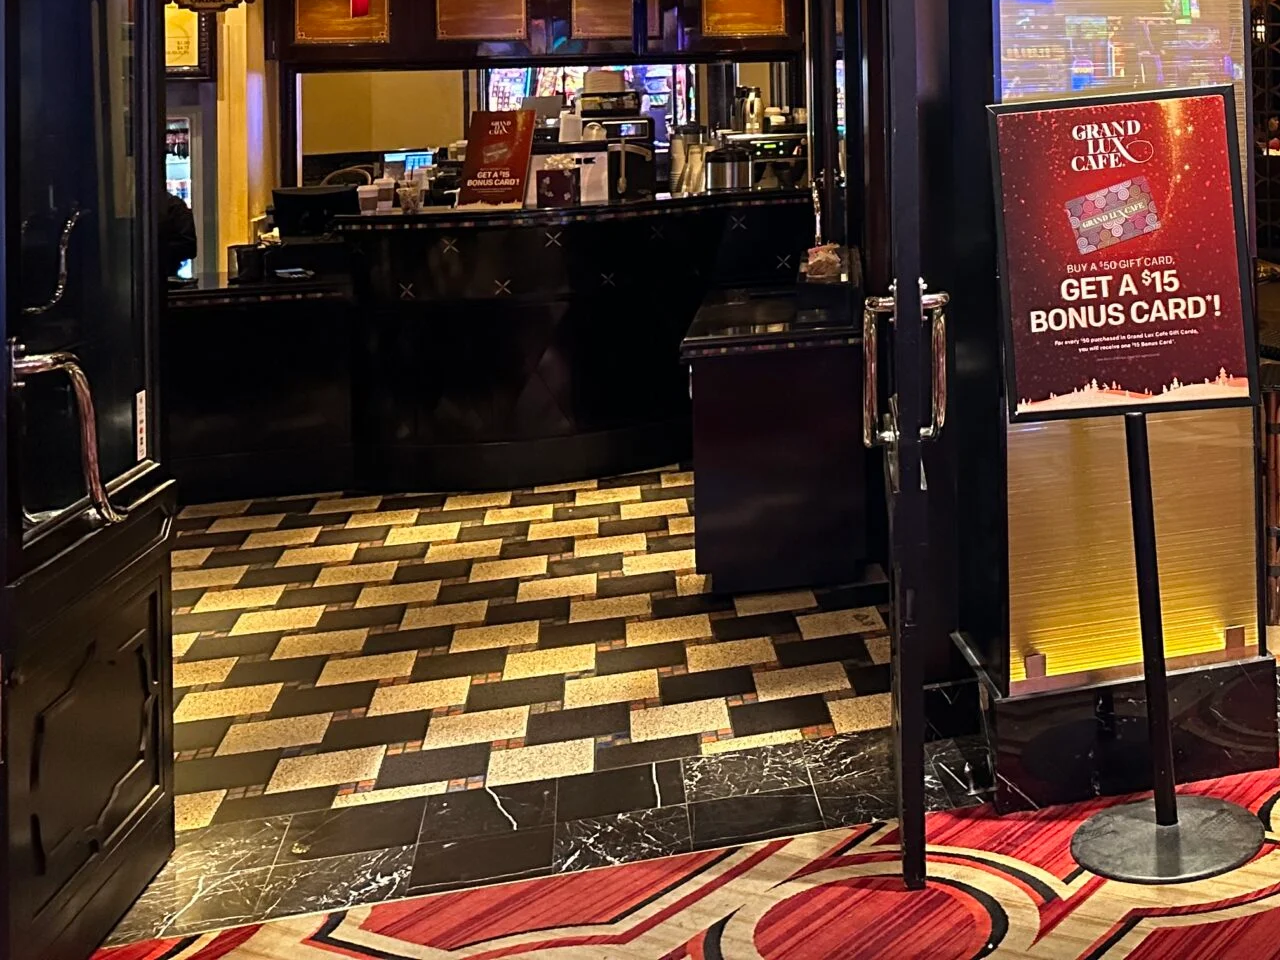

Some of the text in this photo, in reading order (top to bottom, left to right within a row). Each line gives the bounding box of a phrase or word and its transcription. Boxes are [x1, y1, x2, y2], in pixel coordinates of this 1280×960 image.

[1071, 119, 1141, 141] GRAND
[466, 179, 494, 187] BONUS
[476, 170, 492, 179] GET
[1082, 201, 1145, 229] GRAND LUX CAFE
[1066, 263, 1088, 274] BUY
[1090, 262, 1098, 272] A
[1099, 260, 1117, 271] $50
[1118, 257, 1142, 269] GIFT
[1060, 269, 1181, 302] GET A $15
[1030, 302, 1125, 333] BONUS
[1090, 334, 1120, 344] purchased
